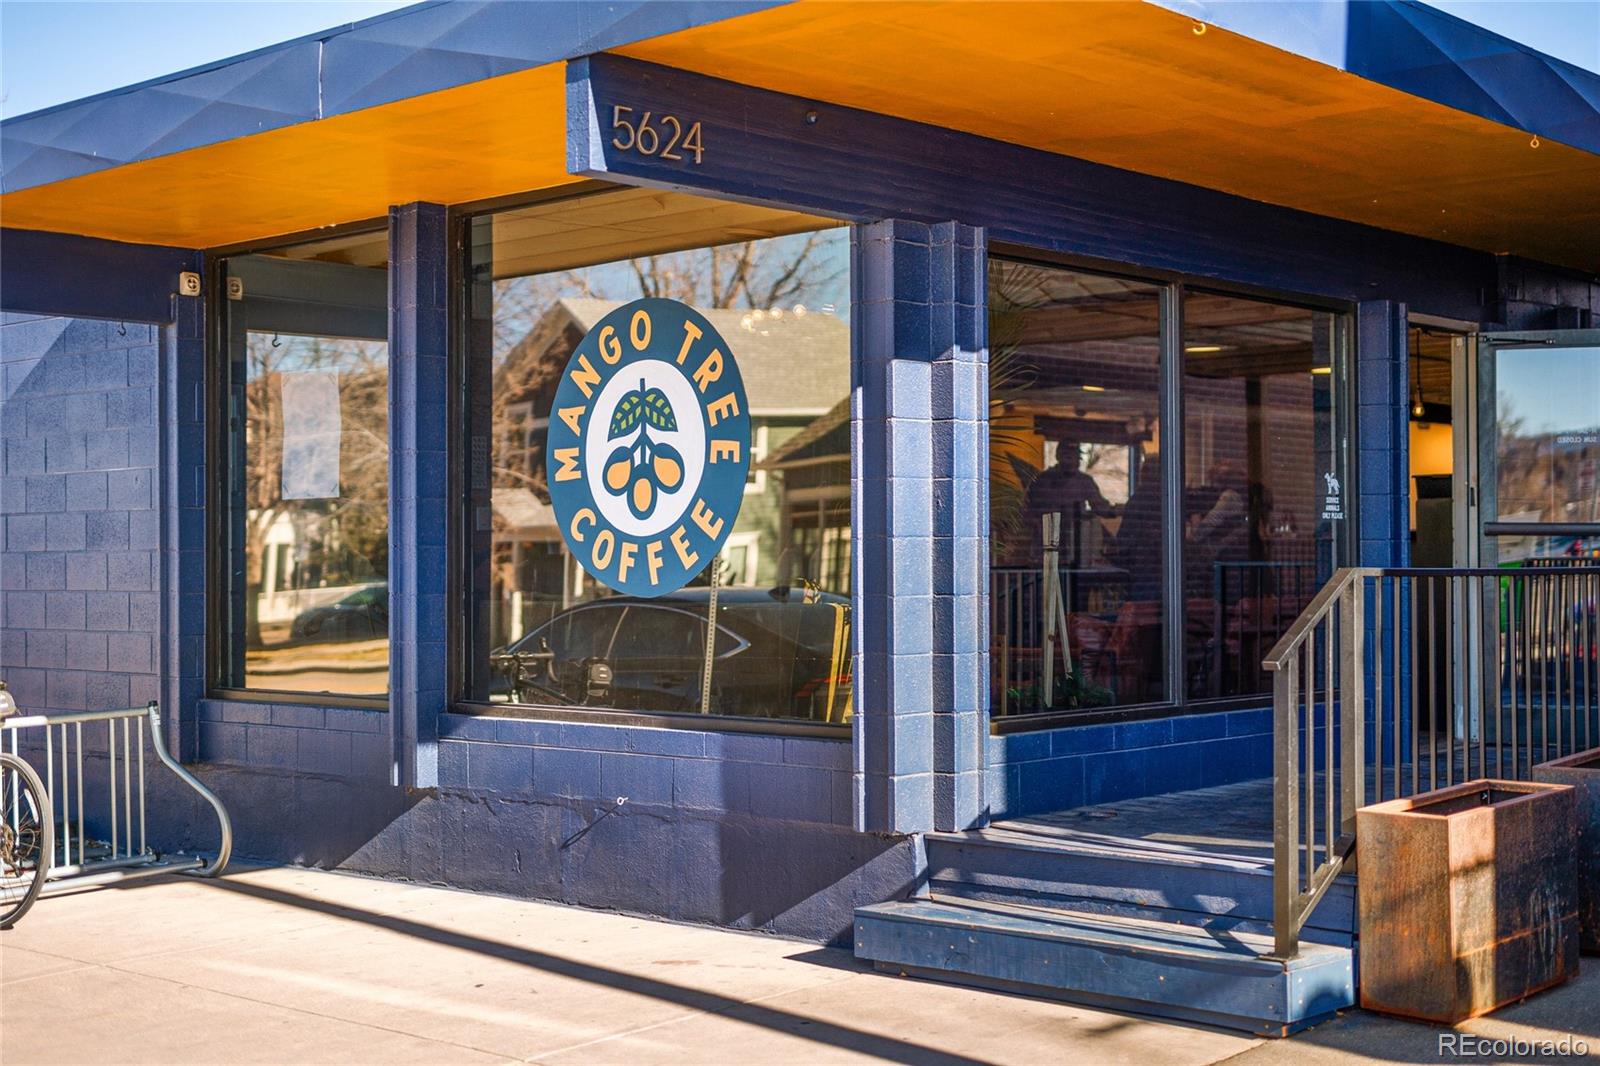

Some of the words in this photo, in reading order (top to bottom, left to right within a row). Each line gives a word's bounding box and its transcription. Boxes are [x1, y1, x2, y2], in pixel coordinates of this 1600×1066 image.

[612, 105, 705, 164] 5624
[554, 310, 651, 482] MANGO
[676, 320, 740, 464] TREE
[570, 499, 724, 586] COFFEE
